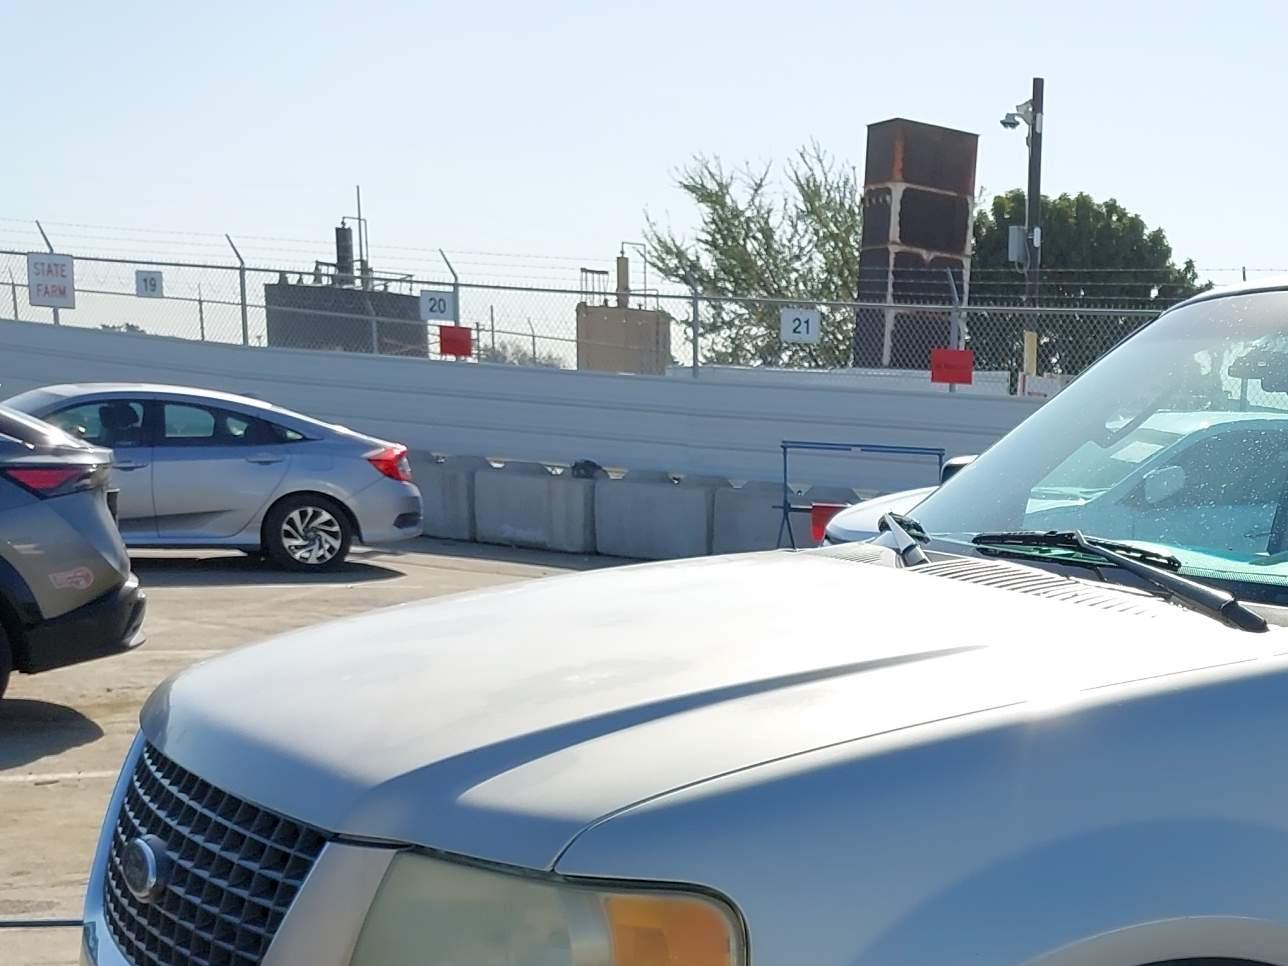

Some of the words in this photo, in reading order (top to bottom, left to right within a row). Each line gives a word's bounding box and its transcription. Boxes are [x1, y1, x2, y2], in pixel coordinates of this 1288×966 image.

[32, 261, 67, 279] STATE
[35, 283, 67, 299] FARM
[141, 276, 157, 293] 19
[428, 296, 447, 314] 20
[791, 316, 811, 335] 21
